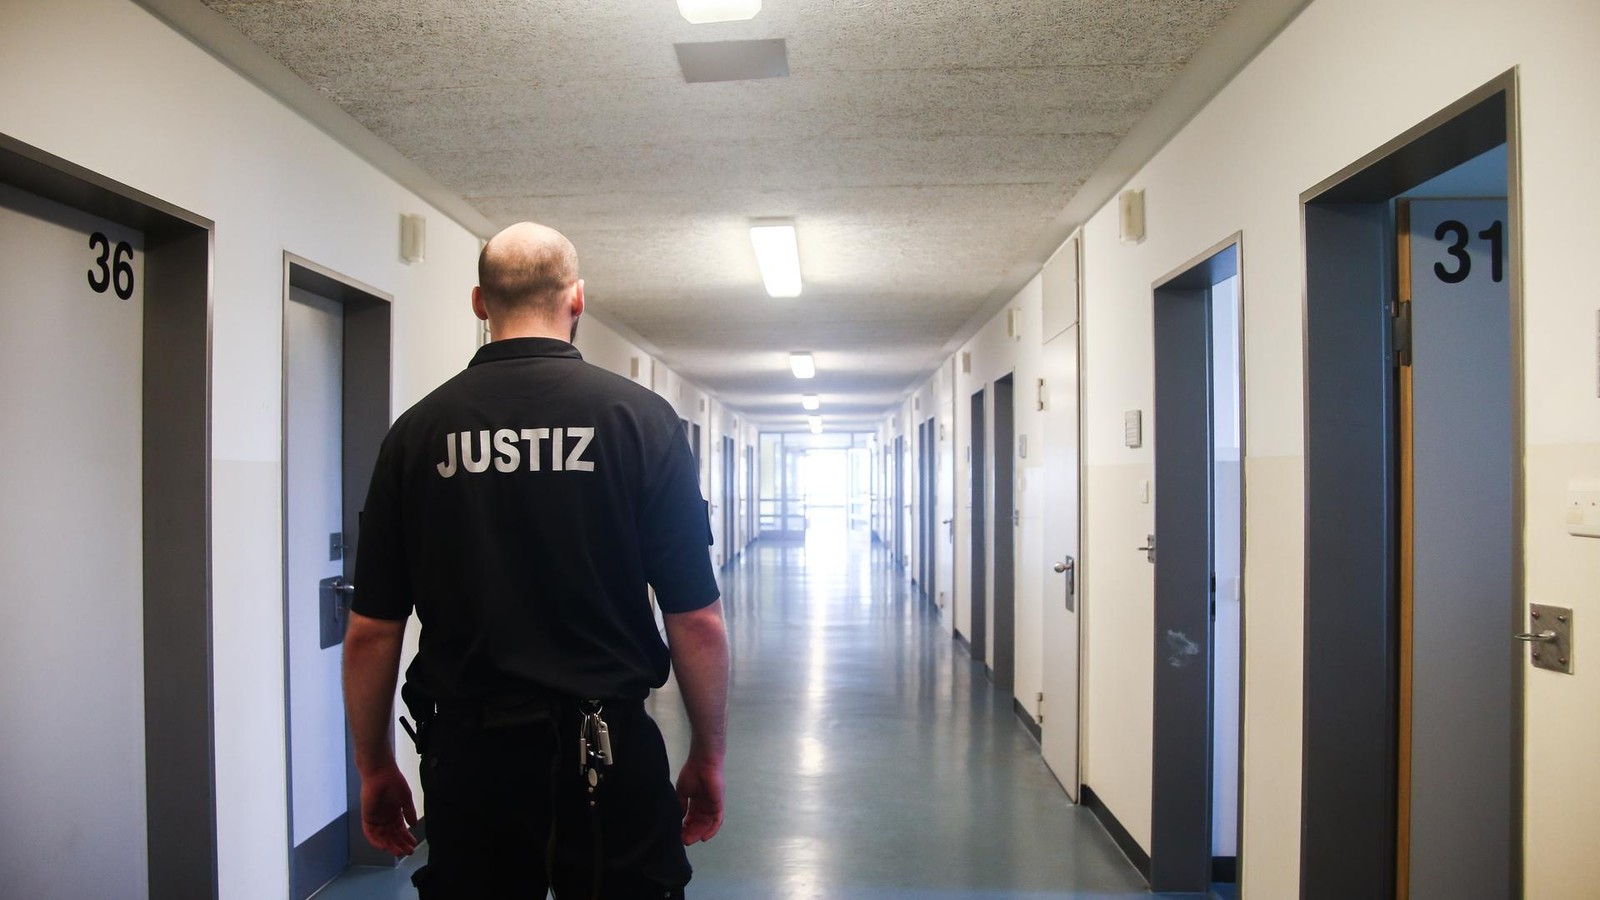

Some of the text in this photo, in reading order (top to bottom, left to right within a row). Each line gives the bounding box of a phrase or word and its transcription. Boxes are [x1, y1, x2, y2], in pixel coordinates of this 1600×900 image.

[87, 232, 134, 300] 36
[1434, 220, 1503, 283] 31
[436, 427, 595, 478] JUSTIZ
